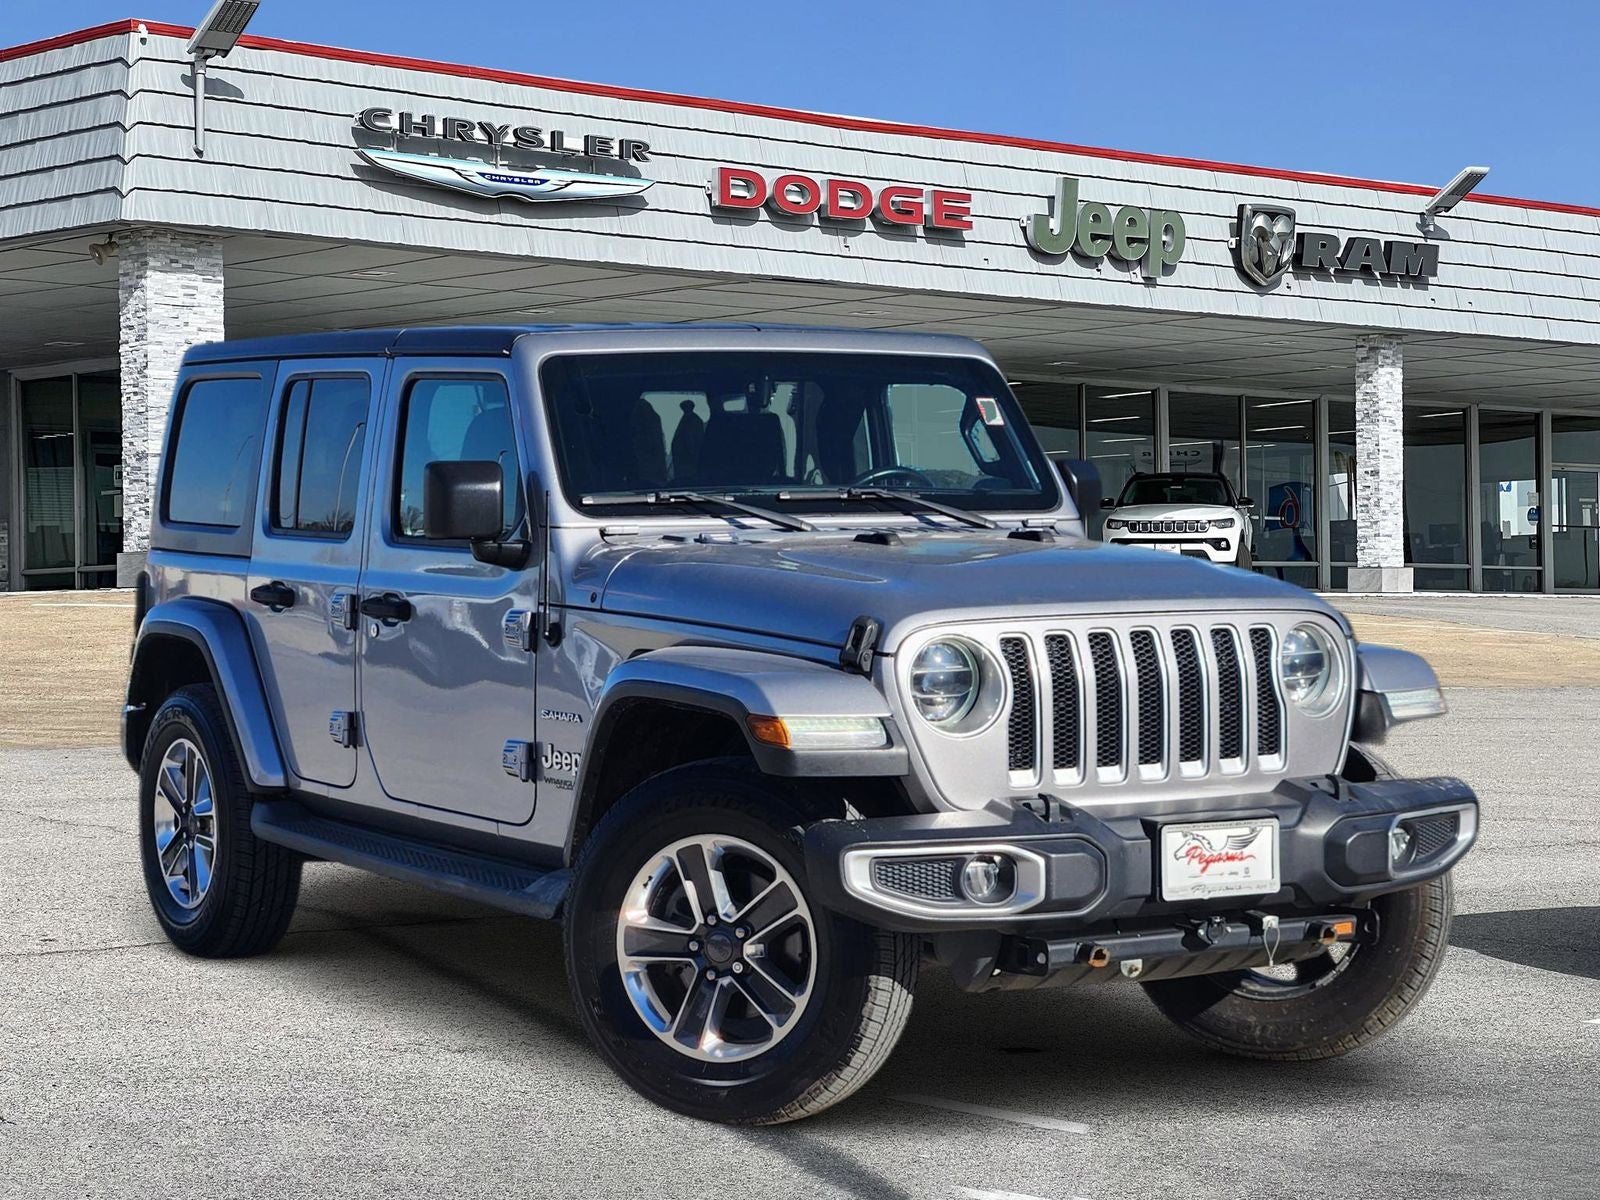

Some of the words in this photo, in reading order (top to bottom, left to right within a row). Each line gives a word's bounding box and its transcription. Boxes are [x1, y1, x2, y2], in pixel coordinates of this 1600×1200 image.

[359, 106, 651, 162] CHRYSLER
[483, 173, 542, 185] CHRYSLER
[712, 166, 974, 231] DODGE
[1026, 176, 1187, 279] Jeep
[1300, 231, 1440, 278] RAM
[541, 708, 583, 724] SAHARA
[541, 743, 582, 776] Jeep
[1185, 844, 1256, 874] Pegasus
